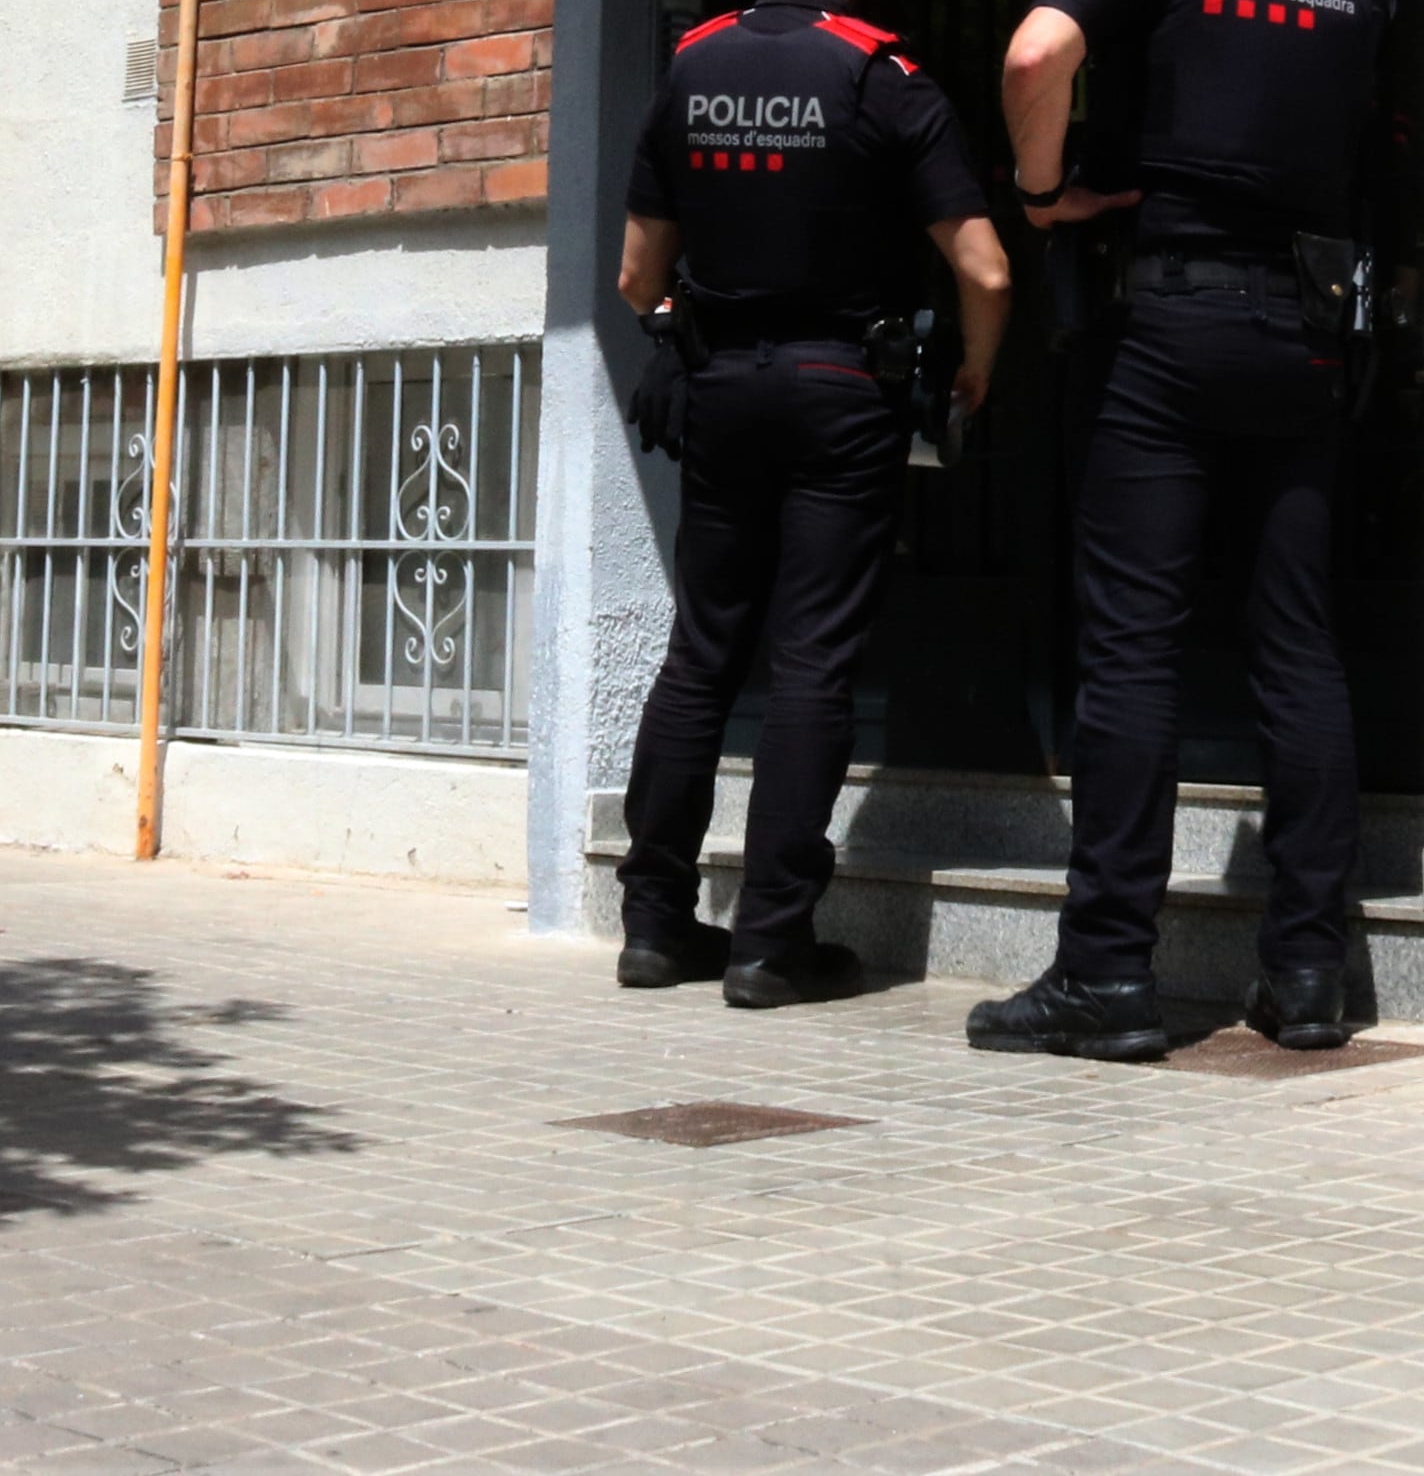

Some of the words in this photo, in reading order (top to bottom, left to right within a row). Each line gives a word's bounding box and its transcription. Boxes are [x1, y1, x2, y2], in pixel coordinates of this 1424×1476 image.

[687, 94, 826, 129] POLICIA
[687, 131, 740, 146] mossos
[743, 129, 826, 151] d'esquadra
